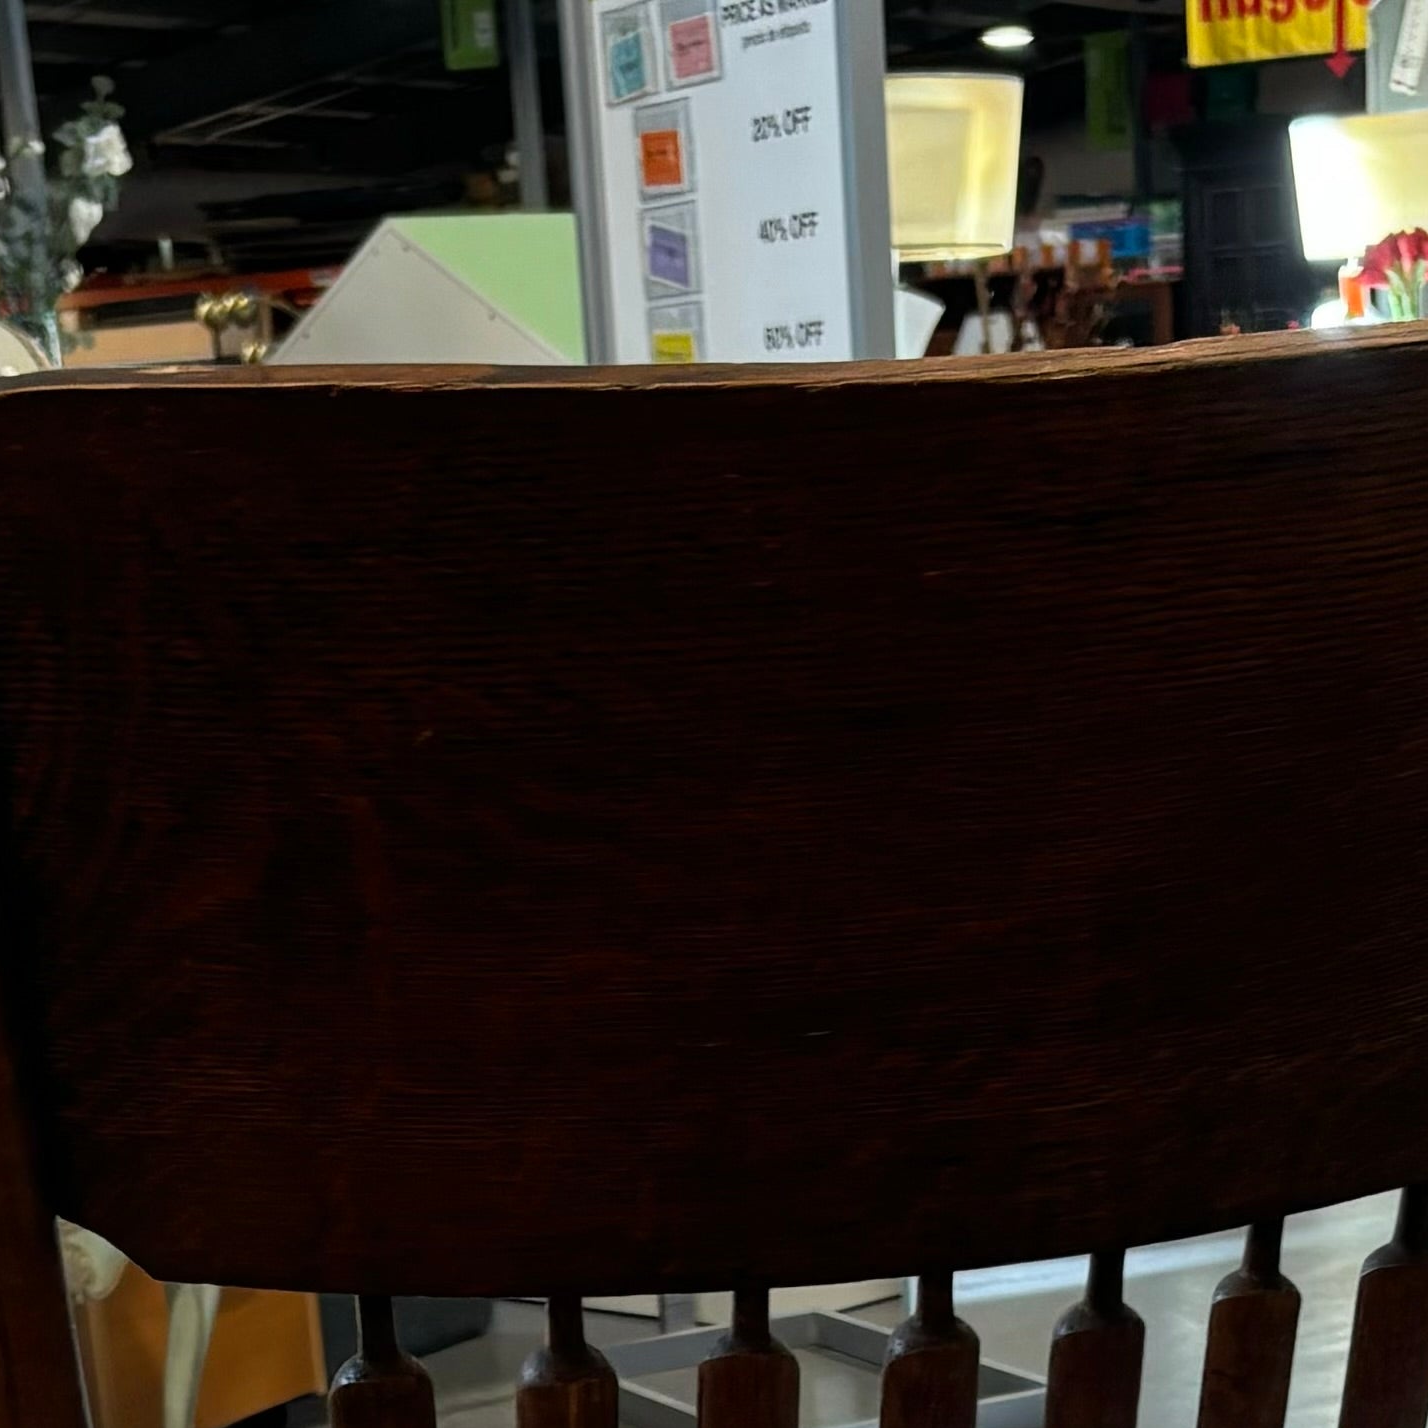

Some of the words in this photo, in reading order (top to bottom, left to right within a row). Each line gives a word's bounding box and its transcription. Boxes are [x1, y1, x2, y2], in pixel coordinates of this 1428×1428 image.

[782, 106, 811, 136] OFF
[759, 218, 789, 243] 40%
[788, 211, 818, 239] OFF
[794, 320, 824, 348] OFF
